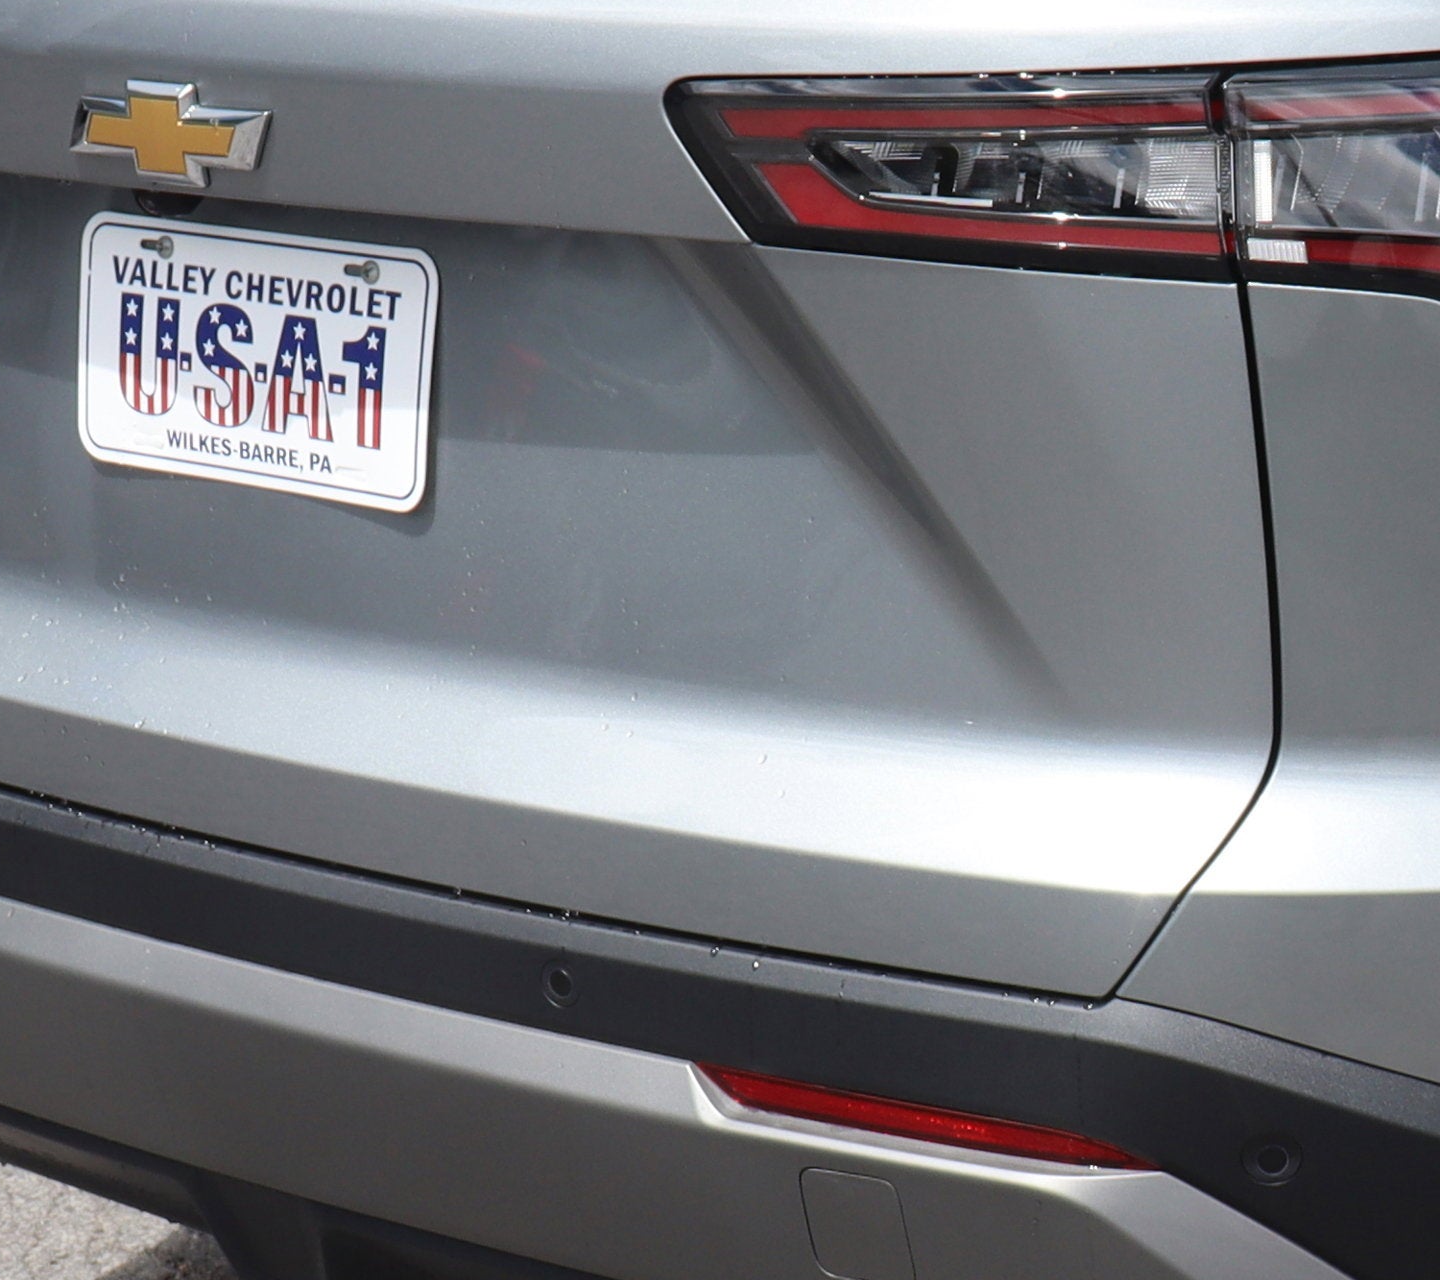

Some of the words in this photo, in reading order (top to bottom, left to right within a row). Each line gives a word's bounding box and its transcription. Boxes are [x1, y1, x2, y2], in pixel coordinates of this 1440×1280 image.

[112, 254, 216, 297] VALLEY
[224, 269, 402, 322] CHEVROLET
[166, 428, 305, 474] WILKES-BARRE,
[309, 454, 333, 475] PA
